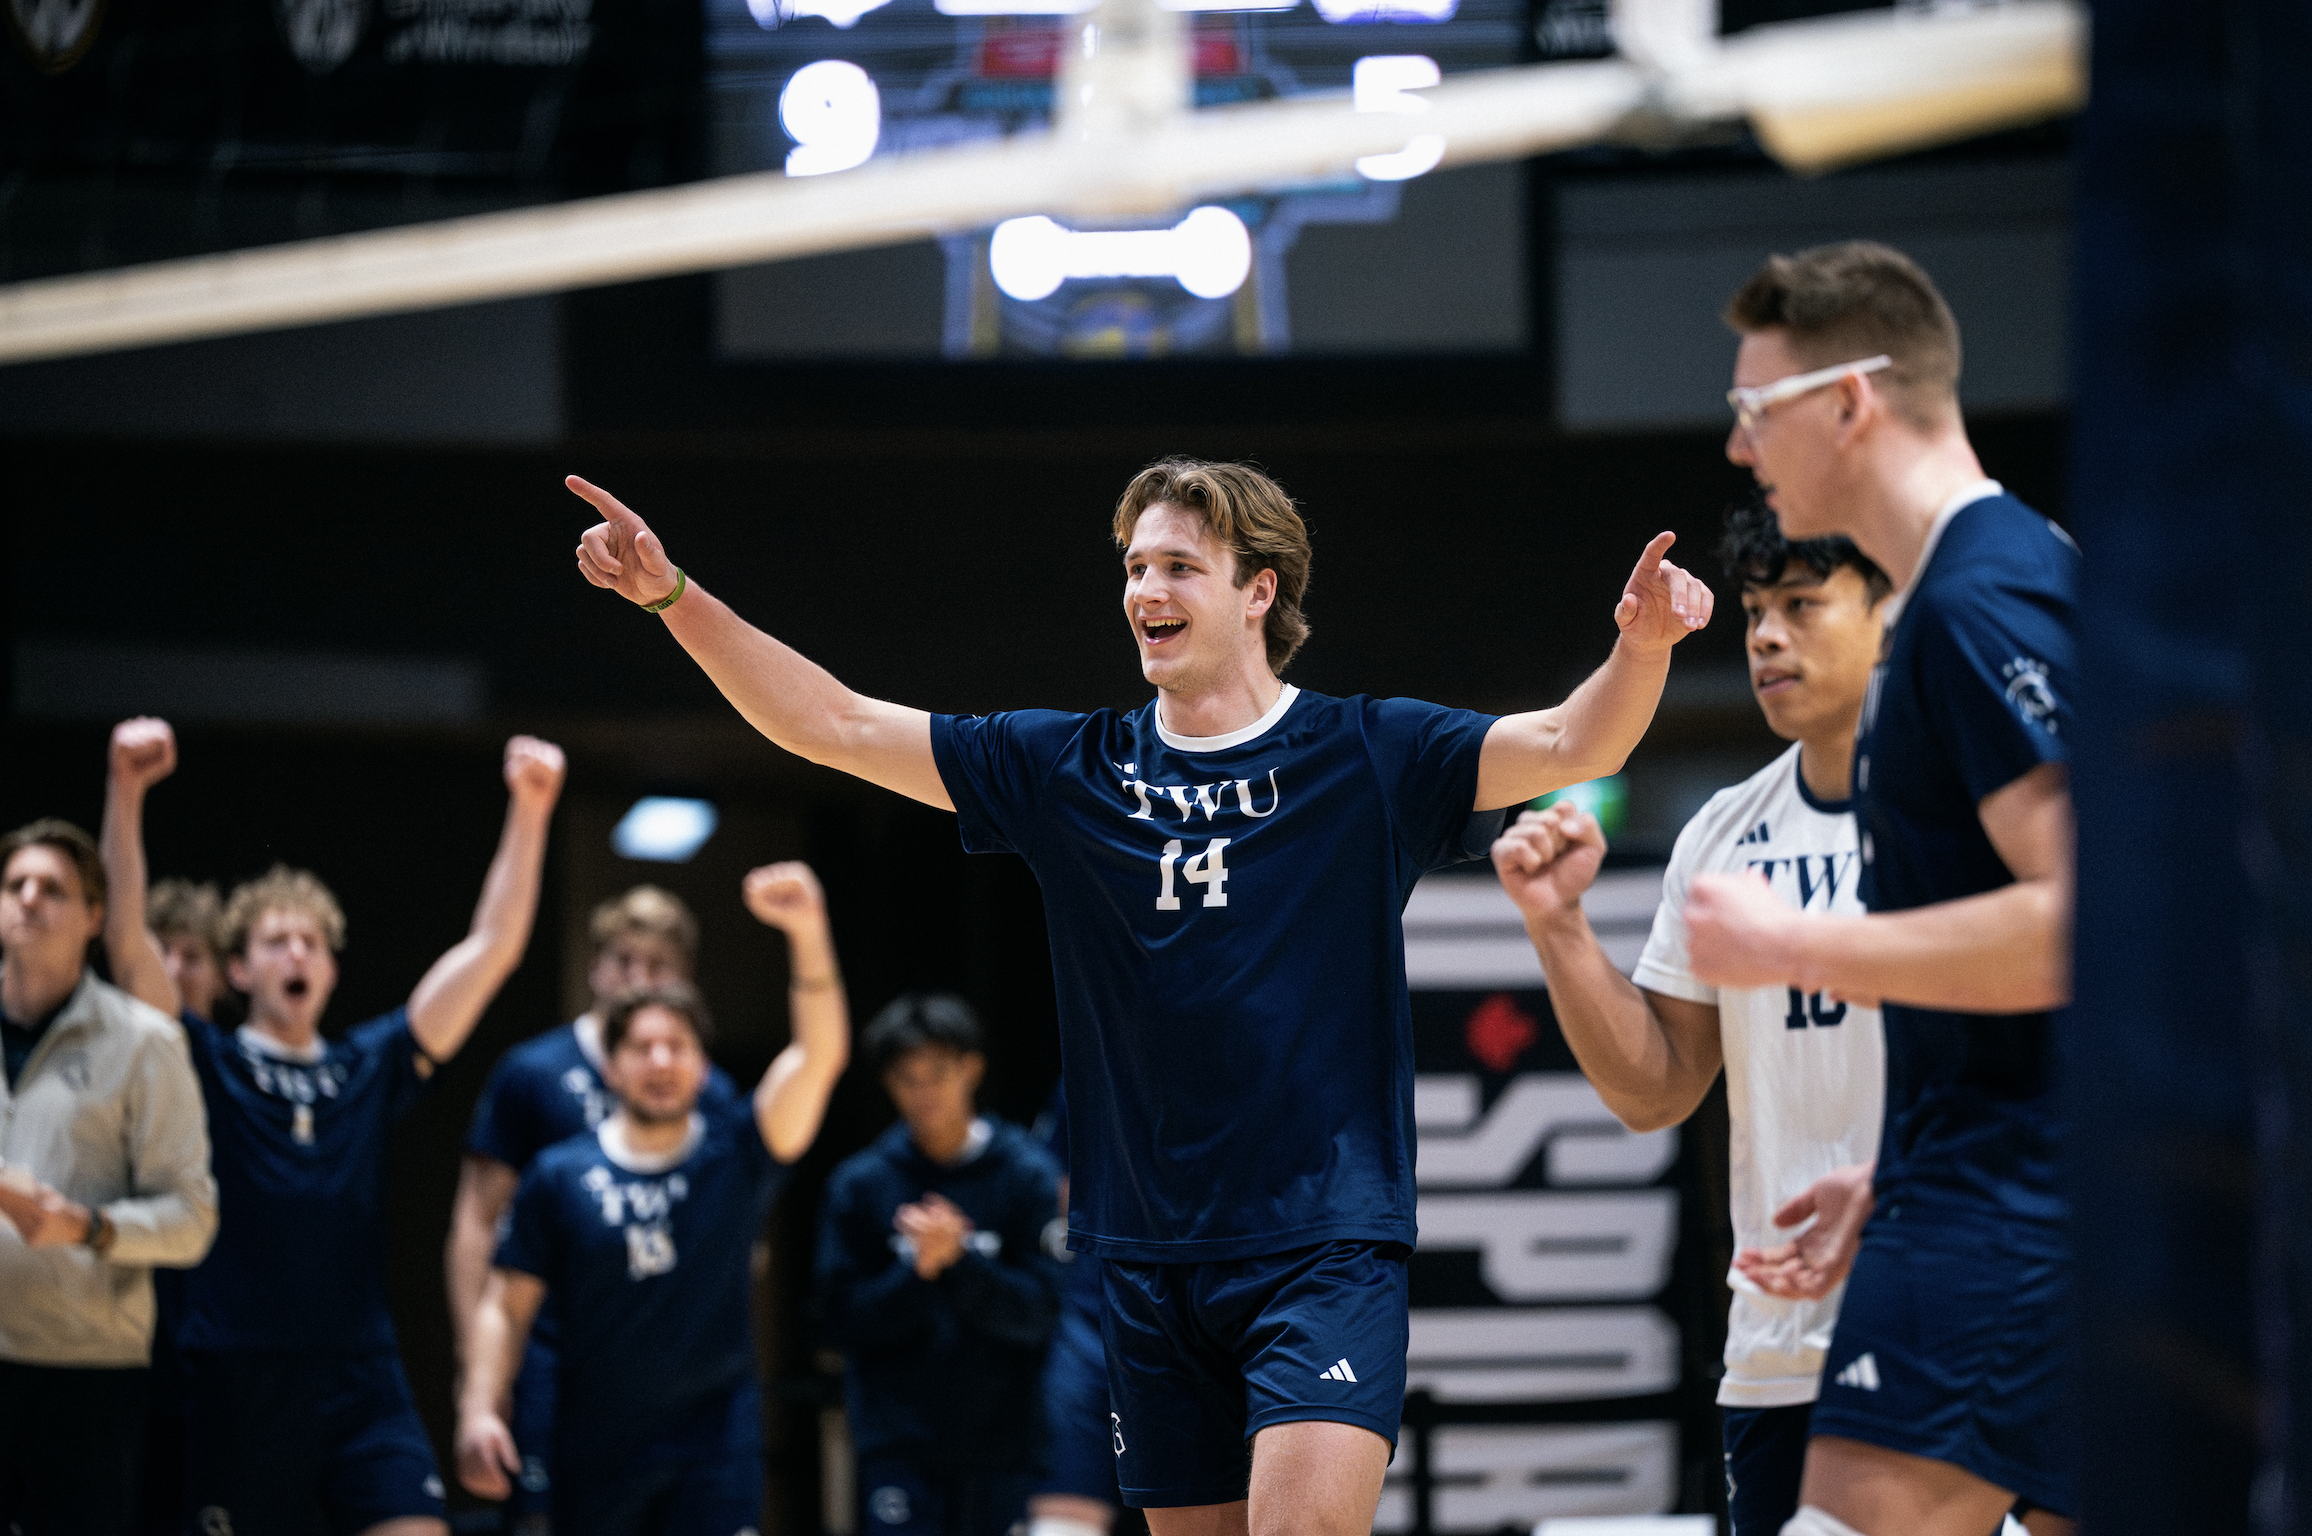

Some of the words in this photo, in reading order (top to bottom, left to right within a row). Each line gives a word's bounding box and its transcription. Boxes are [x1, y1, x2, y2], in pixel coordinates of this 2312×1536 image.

[779, 60, 881, 177] 9
[1354, 55, 1446, 181] 5
[1121, 766, 1279, 823] TWU
[1156, 838, 1231, 910] 14
[1748, 852, 1862, 912] TW
